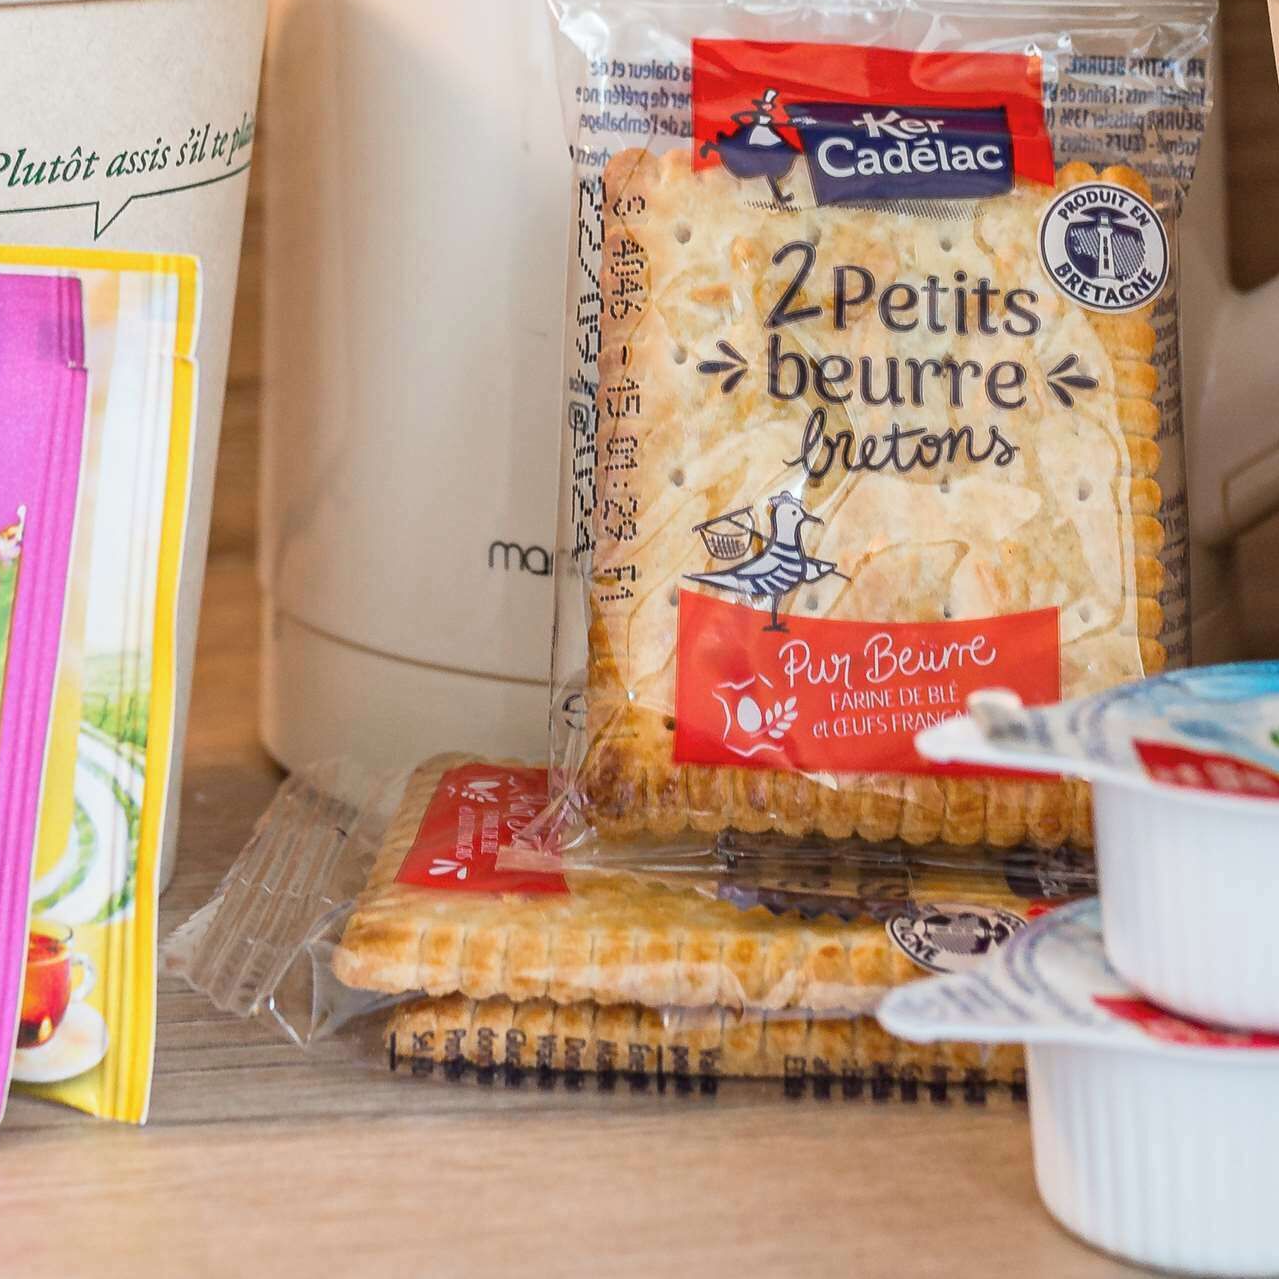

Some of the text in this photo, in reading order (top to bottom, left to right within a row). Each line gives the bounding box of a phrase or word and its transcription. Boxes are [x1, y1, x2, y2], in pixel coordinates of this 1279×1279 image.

[852, 109, 945, 141] Ker
[106, 137, 172, 178] assis
[211, 131, 229, 160] te
[816, 137, 1005, 178] Cadélac
[1057, 190, 1130, 221] PRODUIT
[1129, 205, 1152, 227] EN
[764, 240, 1042, 337] 2 Petits
[1054, 262, 1158, 305] BRETAGNE
[766, 334, 1029, 410] beurre
[782, 406, 1021, 481] bretons
[487, 540, 555, 577] ma
[778, 638, 854, 690] Pur
[830, 680, 961, 712] FARINE DE BLÉ
